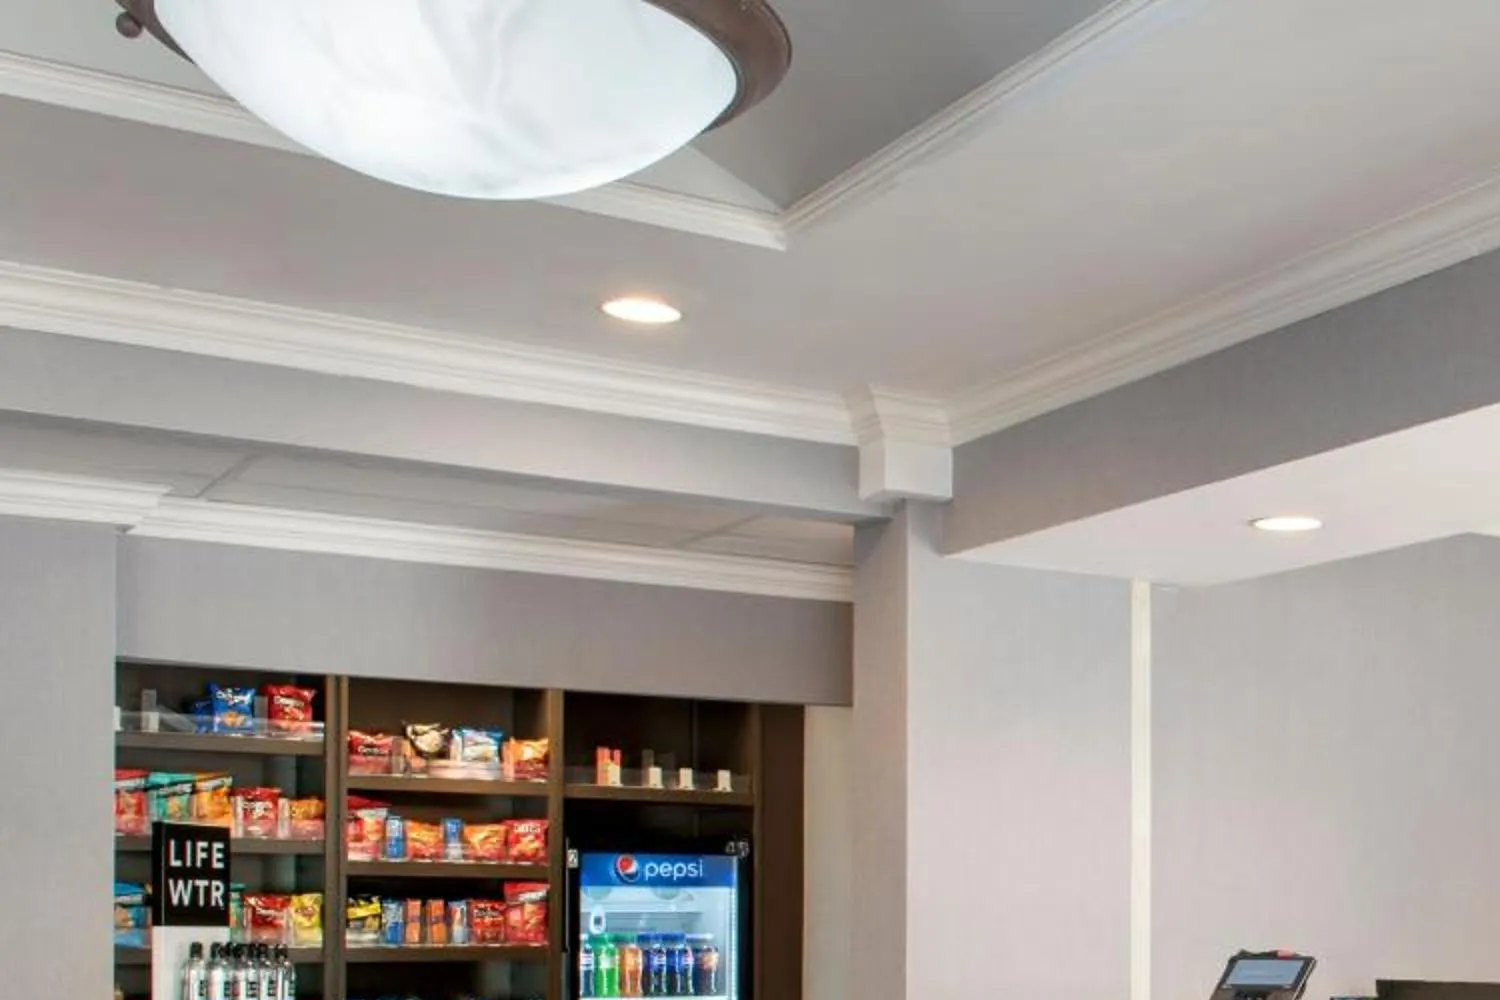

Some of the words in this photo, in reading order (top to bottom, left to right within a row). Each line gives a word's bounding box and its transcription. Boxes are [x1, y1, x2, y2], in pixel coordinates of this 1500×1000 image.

[169, 839, 225, 869] LIFE
[645, 858, 704, 881] pepsi
[168, 878, 225, 909] WTR
